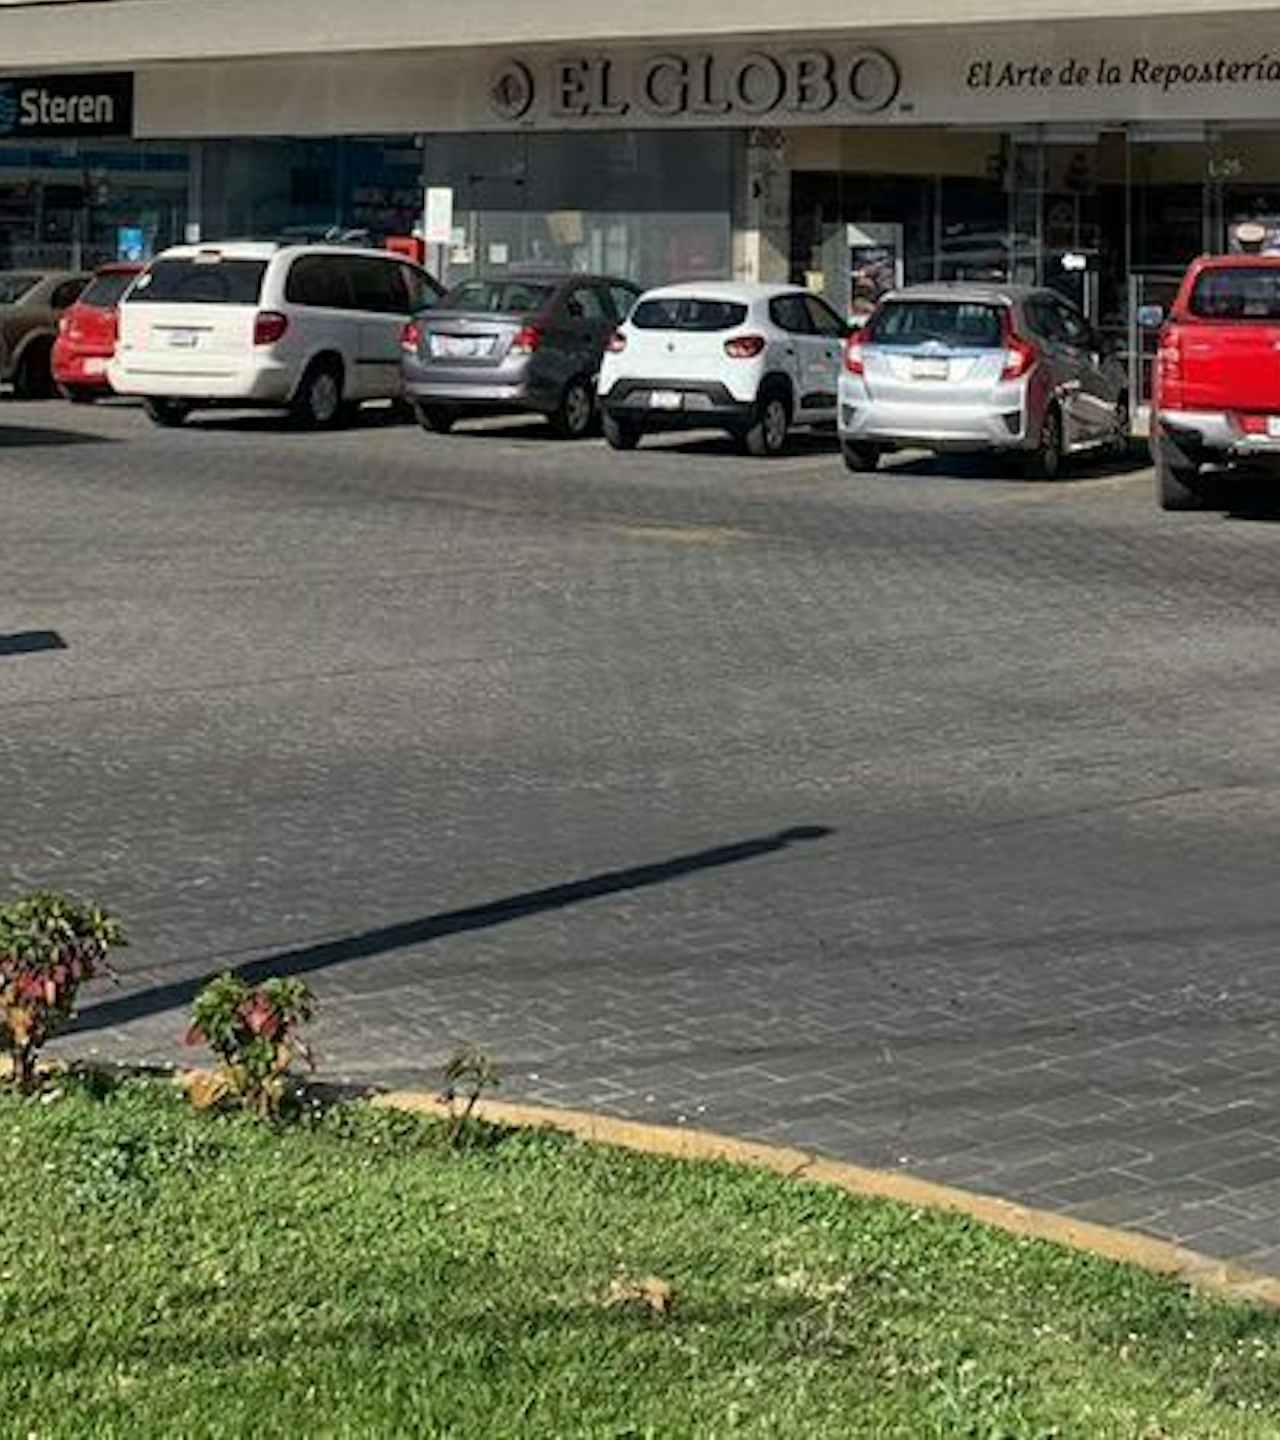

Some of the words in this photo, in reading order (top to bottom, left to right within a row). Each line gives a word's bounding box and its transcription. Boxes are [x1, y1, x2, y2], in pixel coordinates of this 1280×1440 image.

[554, 57, 631, 117] EL
[643, 45, 902, 116] GLOBO
[967, 61, 992, 88] El
[995, 62, 1054, 88] Arte
[1059, 59, 1090, 87] de
[1096, 58, 1121, 85] la
[19, 88, 115, 126] Steren
